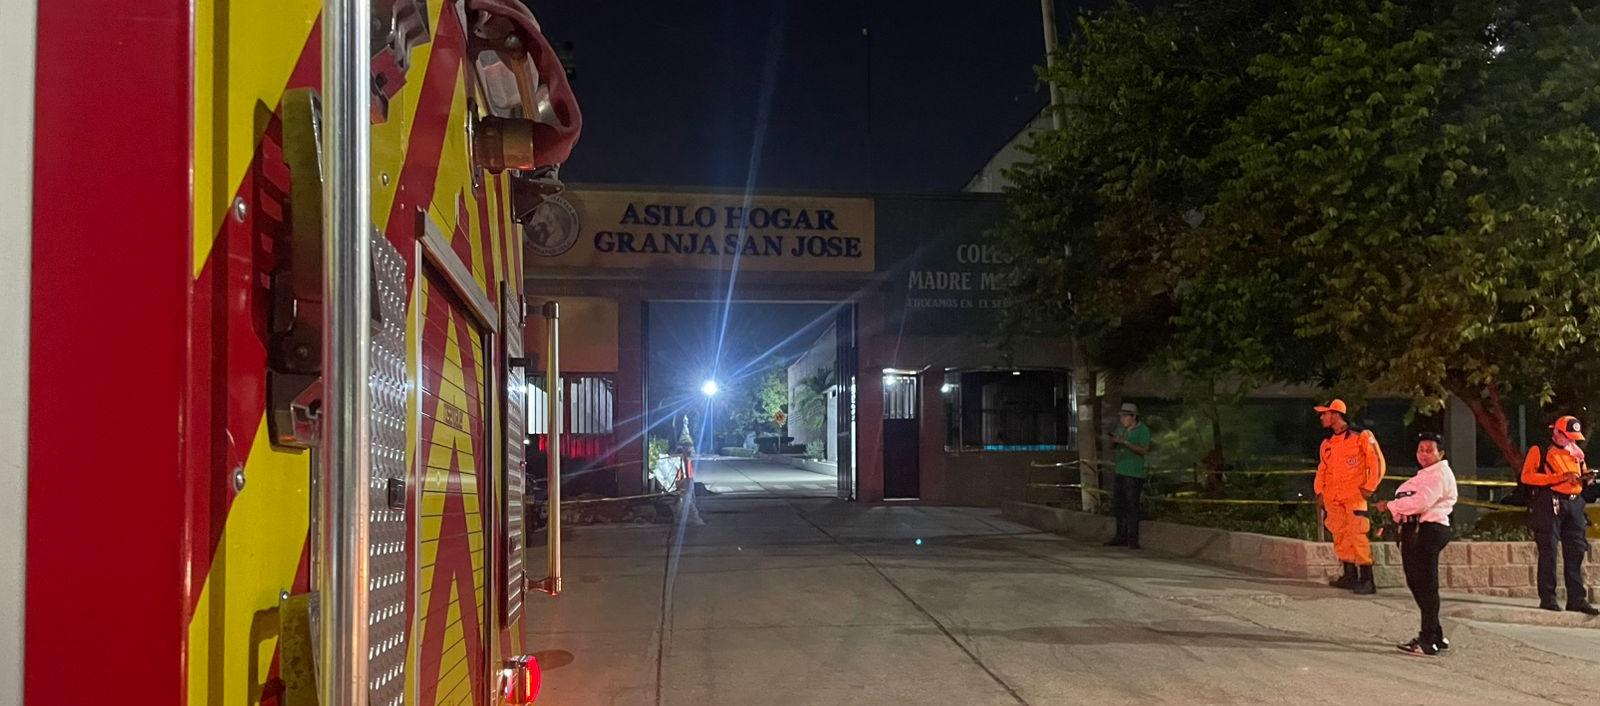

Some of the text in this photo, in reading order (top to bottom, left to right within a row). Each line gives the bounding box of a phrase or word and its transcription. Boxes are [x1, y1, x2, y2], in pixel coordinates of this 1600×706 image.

[619, 203, 839, 231] ASILO HOGAR
[594, 231, 720, 255] GRANJA
[723, 234, 784, 257] SAN
[791, 236, 862, 258] JOSE
[908, 270, 972, 290] MADRE
